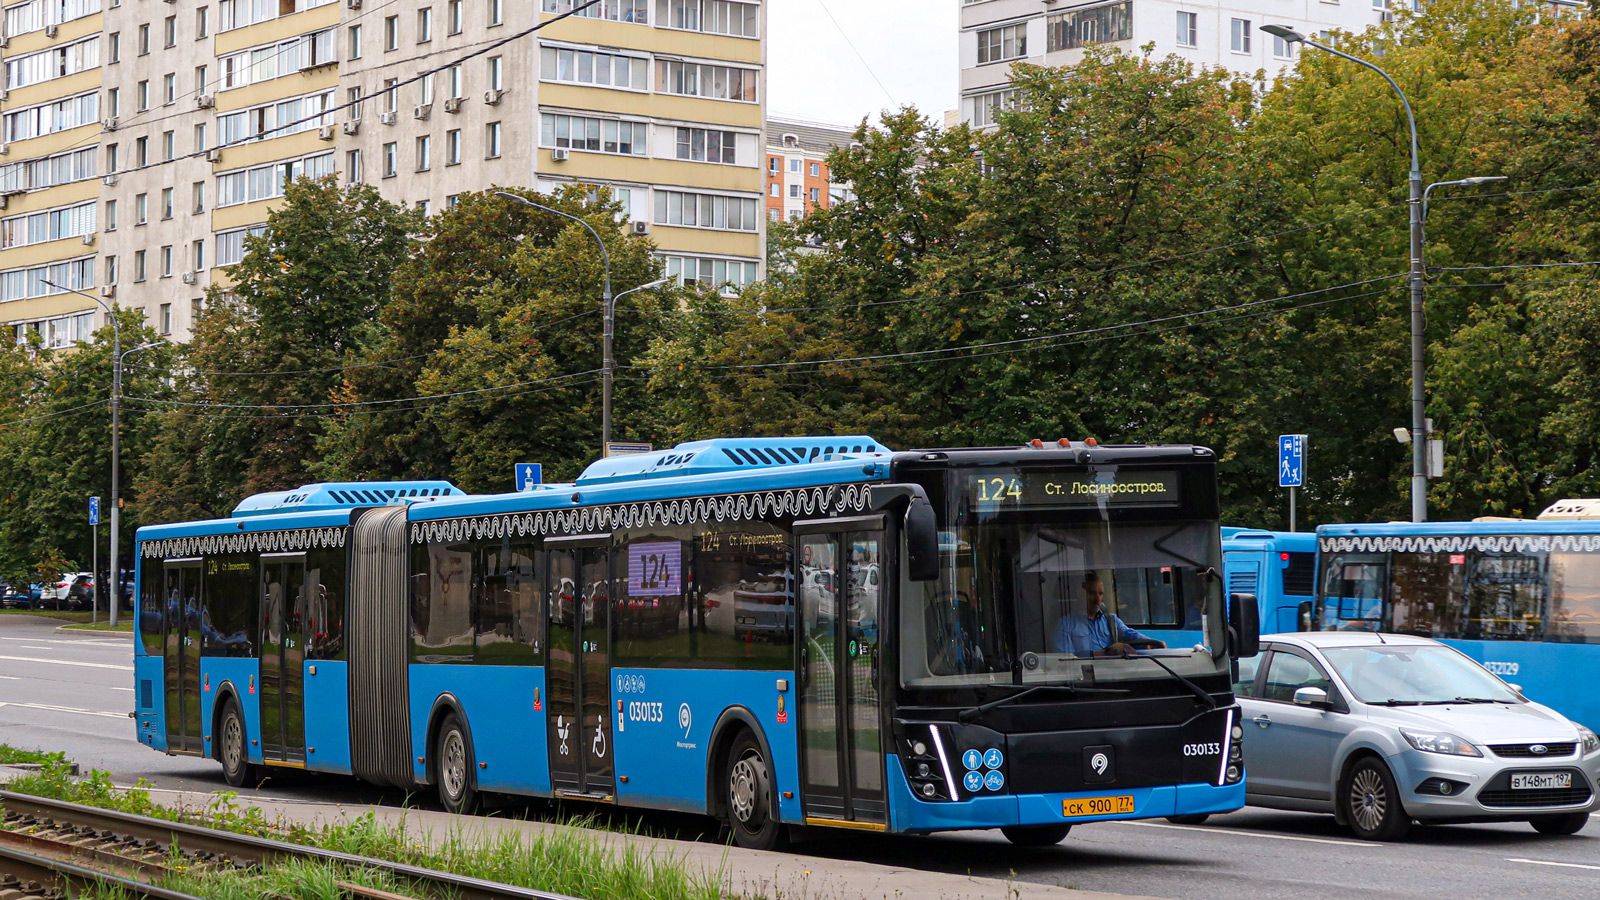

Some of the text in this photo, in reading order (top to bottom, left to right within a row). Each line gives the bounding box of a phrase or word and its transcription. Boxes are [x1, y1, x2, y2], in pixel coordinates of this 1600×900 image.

[977, 477, 1167, 501] 124 Ст. Лосиноостров.
[701, 531, 719, 551] 124
[207, 560, 218, 575] 124
[640, 554, 670, 589] 124
[629, 701, 663, 723] 030133
[1183, 742, 1220, 756] 030133
[1089, 799, 1112, 813] 900
[1118, 797, 1130, 808] 77
